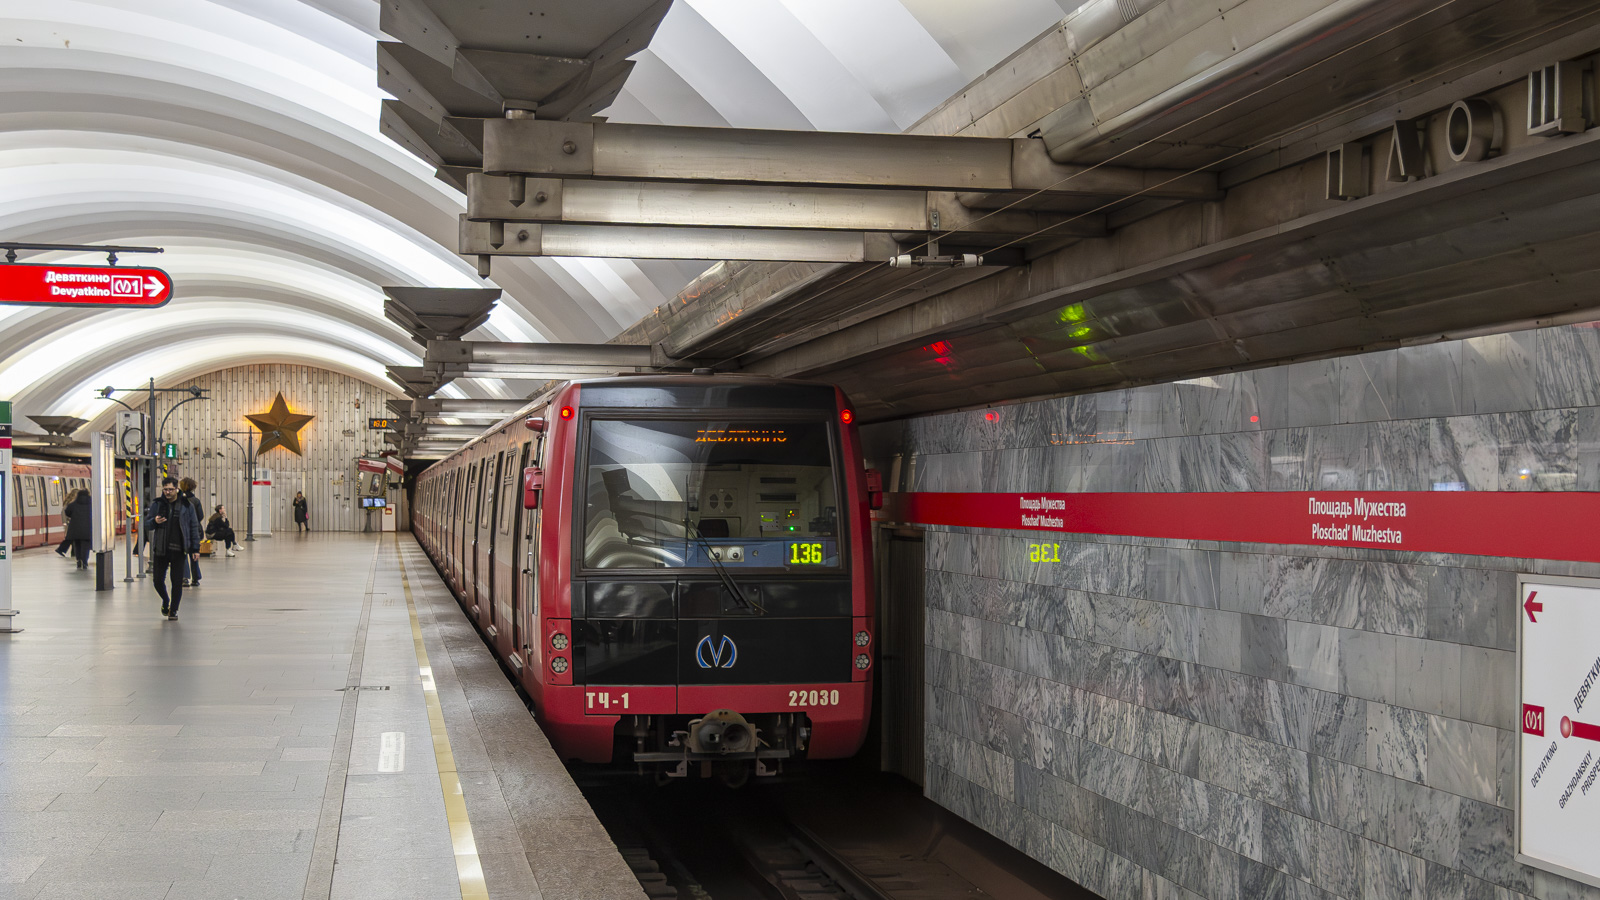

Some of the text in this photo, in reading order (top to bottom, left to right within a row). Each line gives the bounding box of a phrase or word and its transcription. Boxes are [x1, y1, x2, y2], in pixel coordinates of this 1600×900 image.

[45, 271, 110, 283] Девяткино
[51, 286, 110, 298] Devyatkino
[1019, 497, 1065, 513] Площадь Мужества
[1308, 497, 1406, 521] Площадь Мужества
[1040, 515, 1063, 528] Muzhestva
[1352, 525, 1402, 544] Muzhestva
[790, 543, 822, 564] 136
[585, 692, 629, 709] ТЧ-1
[788, 690, 839, 707] 22030
[1530, 741, 1558, 789] DEVYATKINO
[1558, 750, 1593, 809] GRAZHDANSKIY
[1581, 757, 1600, 796] PROSPE
